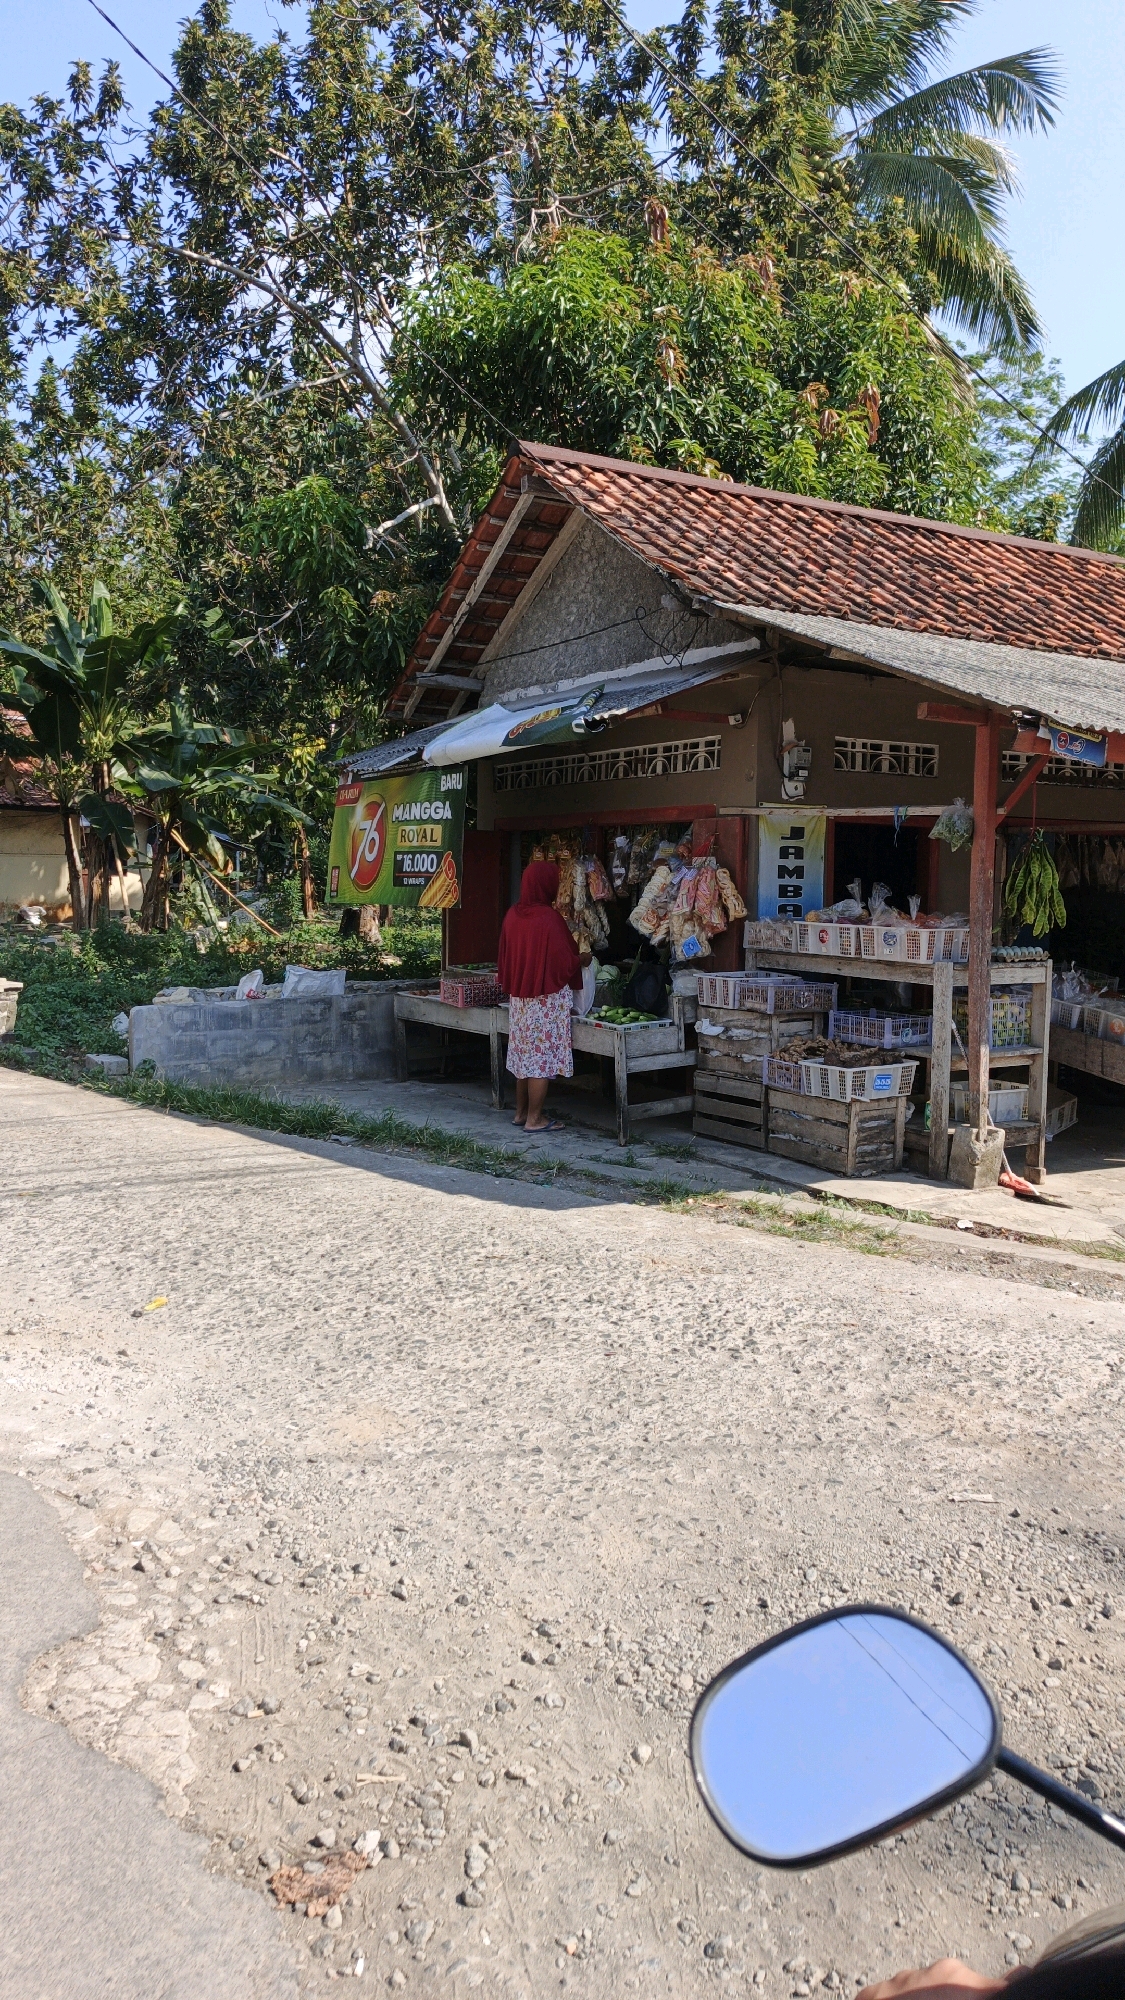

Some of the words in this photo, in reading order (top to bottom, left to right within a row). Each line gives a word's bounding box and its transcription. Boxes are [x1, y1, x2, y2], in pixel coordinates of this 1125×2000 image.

[440, 772, 463, 791] BARU
[392, 801, 452, 822] MANGGA
[350, 801, 386, 880] 76
[400, 827, 438, 843] ROYAL
[402, 853, 437, 872] 16.000
[408, 877, 425, 885] WRAPS
